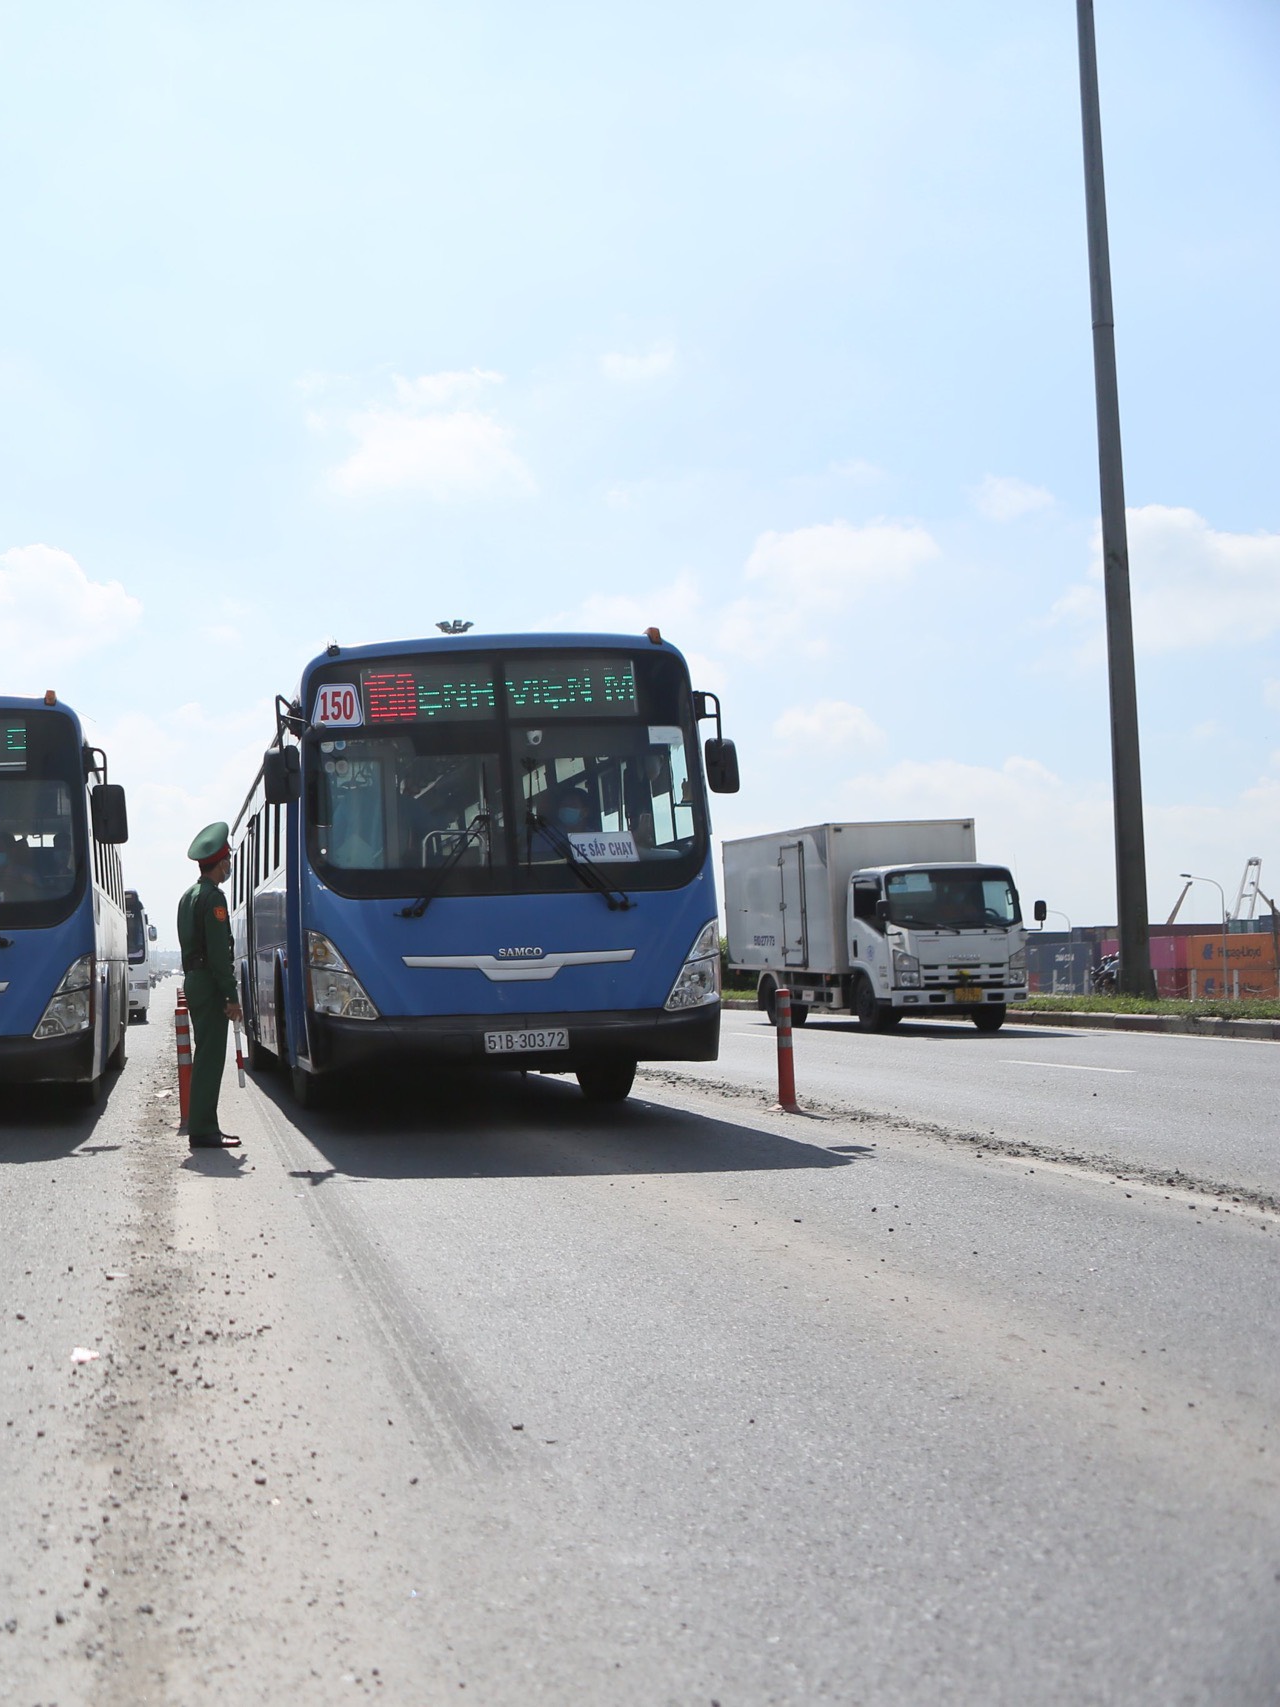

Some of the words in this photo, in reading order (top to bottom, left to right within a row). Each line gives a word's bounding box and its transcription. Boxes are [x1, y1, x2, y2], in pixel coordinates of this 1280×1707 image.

[320, 690, 354, 721] 150
[588, 838, 606, 857] SẮP
[608, 842, 634, 858] CHẠY
[498, 947, 543, 957] SAMCO
[487, 1031, 566, 1050] 51B-303.72
